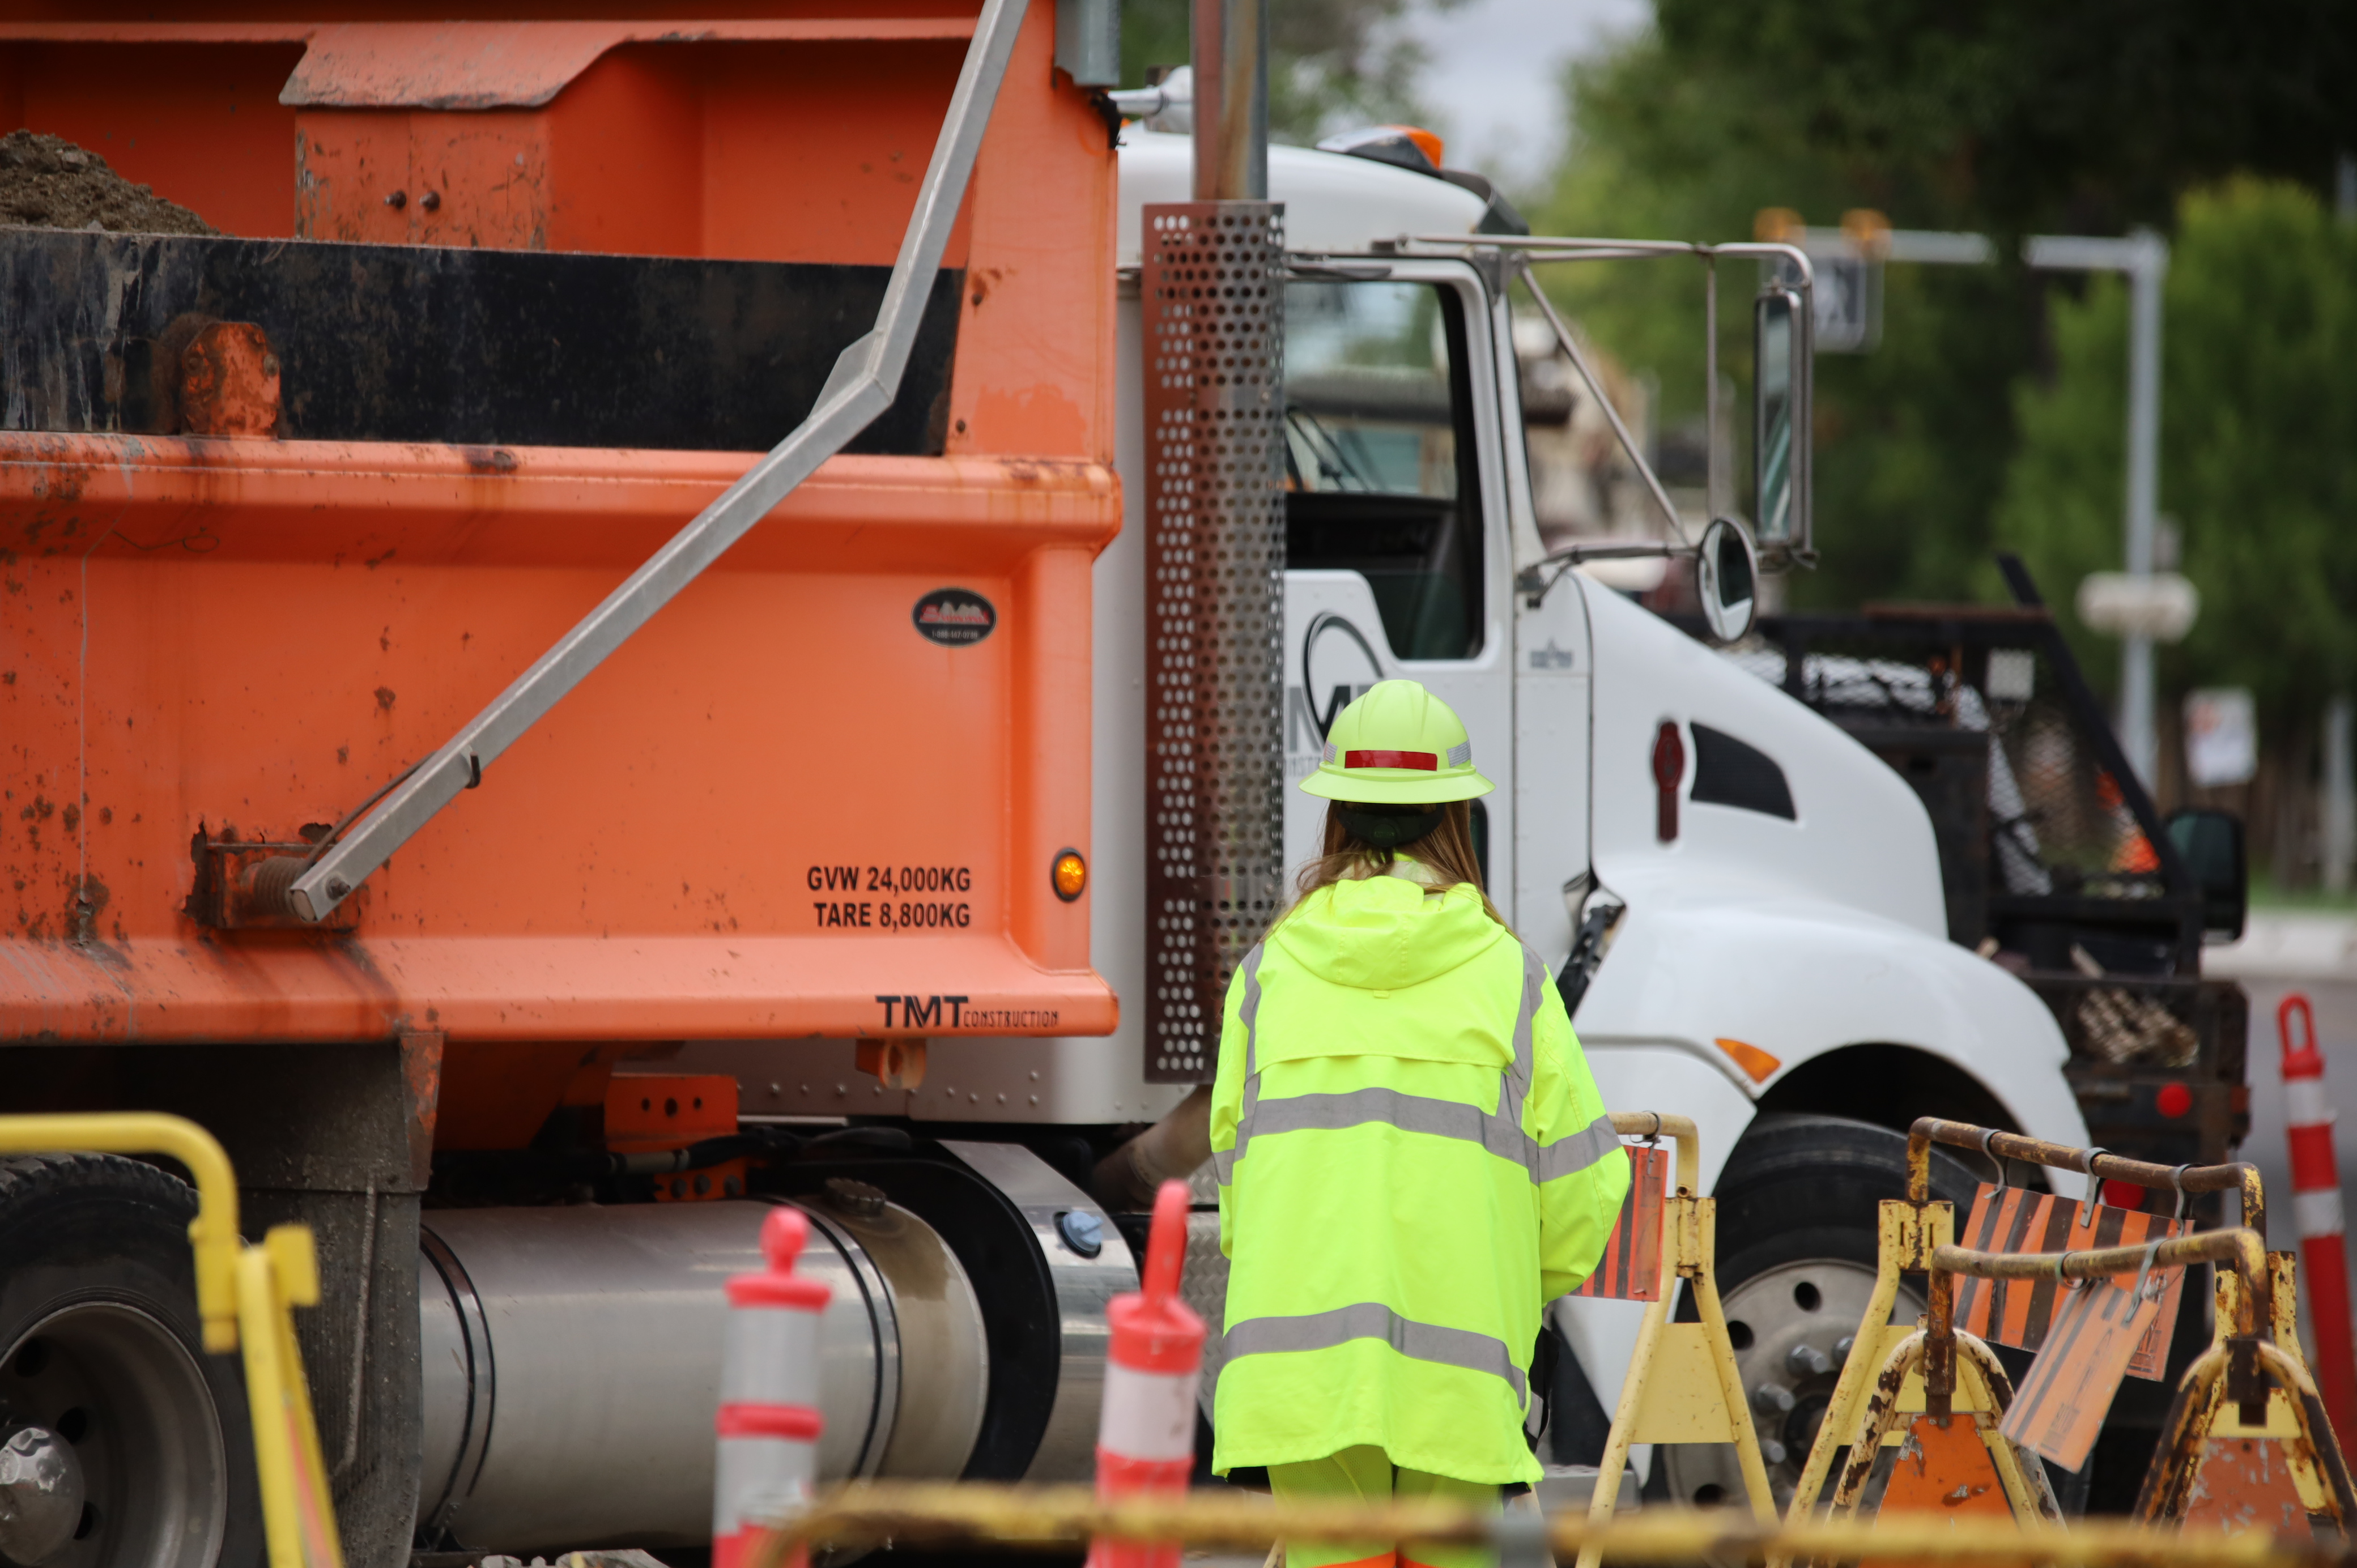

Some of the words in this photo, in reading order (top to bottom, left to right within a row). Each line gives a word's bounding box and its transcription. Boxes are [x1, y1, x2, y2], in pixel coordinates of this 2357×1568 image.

[807, 866, 859, 891] GVW
[866, 866, 971, 897] 24,000KG
[812, 902, 871, 927] TARE
[879, 902, 969, 933] 8,800KG
[875, 995, 968, 1028] TMT
[964, 1011, 1058, 1028] CONSTRUCTION
